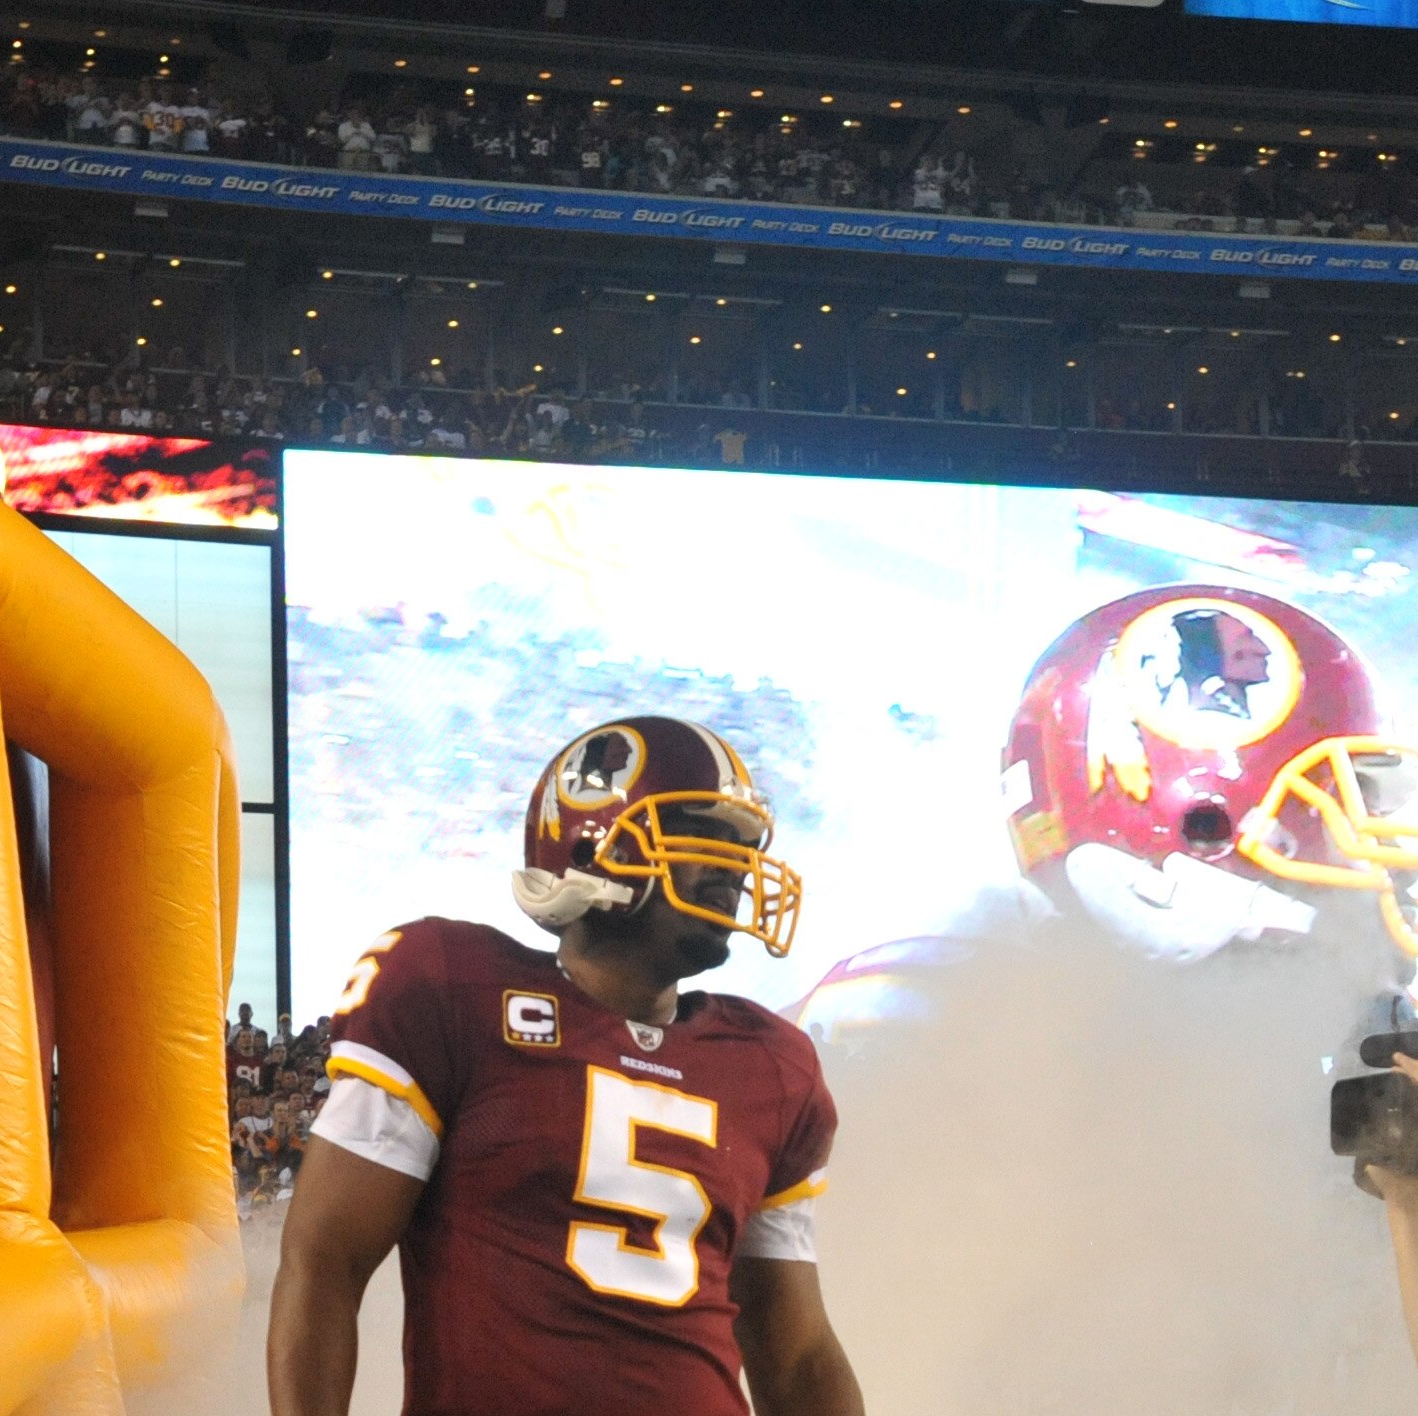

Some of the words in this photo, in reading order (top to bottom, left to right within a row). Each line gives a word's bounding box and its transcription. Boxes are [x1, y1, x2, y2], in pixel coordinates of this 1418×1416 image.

[10, 154, 59, 172] BUD
[70, 160, 132, 178] LIGHT
[141, 170, 183, 184] PARTY
[181, 174, 215, 188] DECK
[221, 175, 269, 192] BUD
[278, 182, 341, 199] LIGHT
[348, 190, 387, 204] PARTY
[388, 193, 420, 206] DECK
[429, 194, 476, 210] BUD
[484, 199, 545, 215] LIGHT
[632, 208, 677, 224] BUD
[686, 214, 746, 229] LIGHT
[827, 222, 873, 238] BUD
[881, 227, 939, 242] LIGHT
[1022, 236, 1066, 252] BUD
[1074, 241, 1130, 256] LIGHT
[1209, 248, 1254, 263] BUD
[1261, 252, 1318, 267] LIGHT
[333, 929, 403, 1016] 5
[507, 995, 555, 1035] C
[619, 1054, 684, 1080] REDSKINS
[565, 1065, 718, 1307] 5
